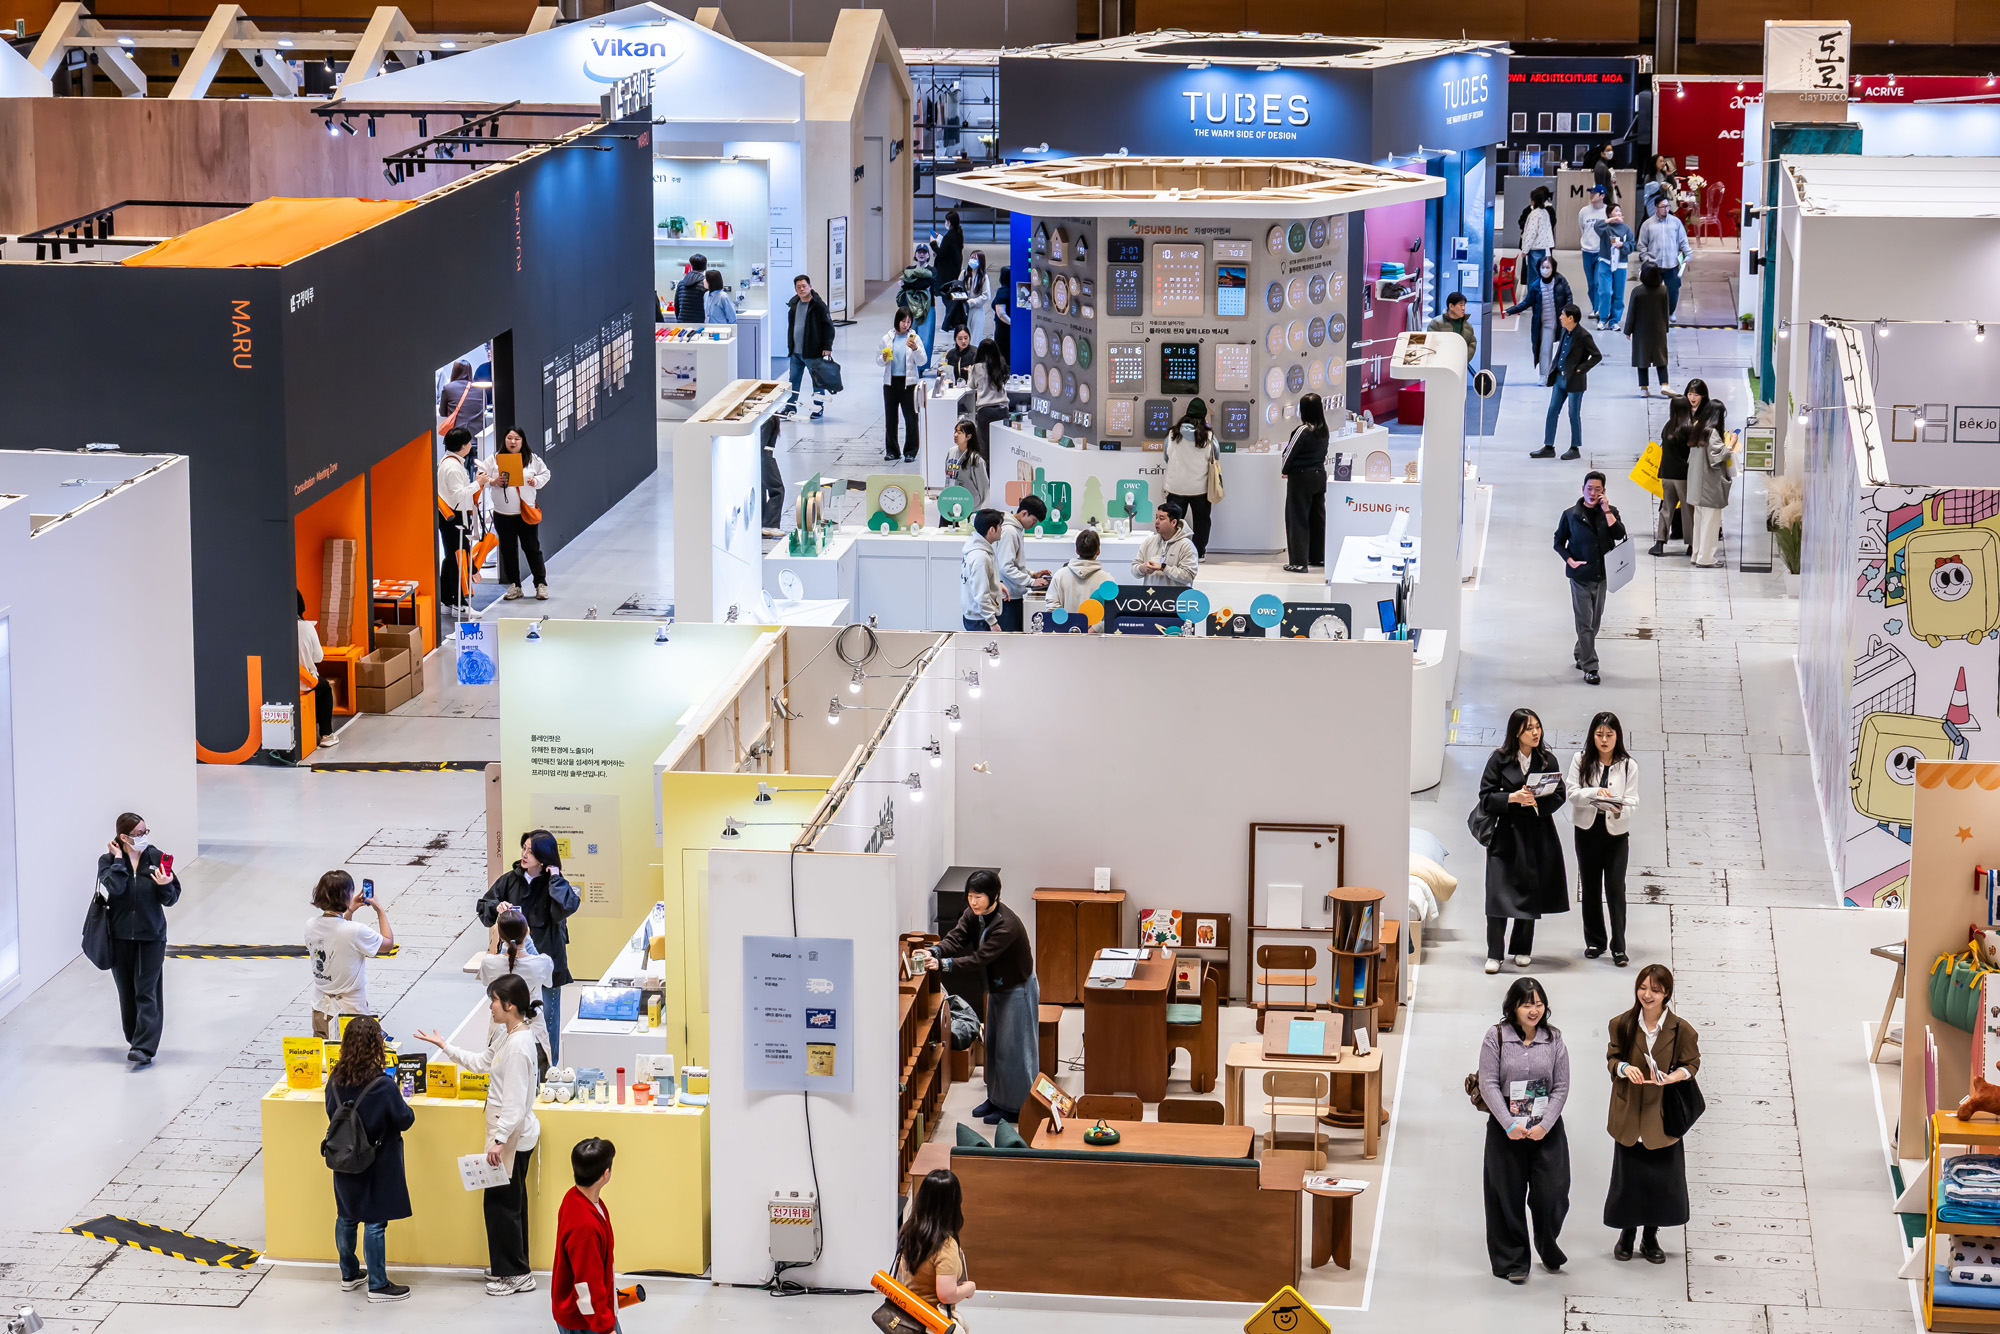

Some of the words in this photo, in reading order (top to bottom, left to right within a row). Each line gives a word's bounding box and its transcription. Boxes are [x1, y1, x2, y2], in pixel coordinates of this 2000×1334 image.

[590, 38, 666, 57] Vikan
[1601, 74, 1623, 83] MOA
[1443, 73, 1489, 110] TUBES
[1865, 86, 1905, 97] ACRIVE
[1182, 92, 1310, 126] TUBES
[1194, 128, 1209, 137] THE
[1211, 129, 1235, 138] WARM
[1236, 130, 1254, 139] SIDE
[1256, 131, 1267, 139] OF
[1268, 131, 1297, 140] DESIGN
[514, 190, 522, 272] KUJUNG
[1135, 225, 1171, 235] JISUNG
[1174, 225, 1188, 235] inc
[231, 300, 252, 369] MARU
[1353, 503, 1392, 513] JISUNG
[1395, 503, 1410, 513] inc
[1114, 598, 1200, 613] VOYAGER
[460, 630, 484, 641] D-313
[531, 746, 549, 754] 유해한
[550, 746, 569, 754] 환경에
[569, 747, 594, 755] 노출되어
[531, 757, 555, 765] 예민해진
[556, 758, 575, 766] 일상을
[576, 758, 600, 767] 섬세하게
[601, 759, 625, 767] 케어하는
[531, 769, 556, 777] 프리미엄
[570, 770, 608, 778] 솔루션입니다.
[773, 1208, 810, 1218] 전기위험
